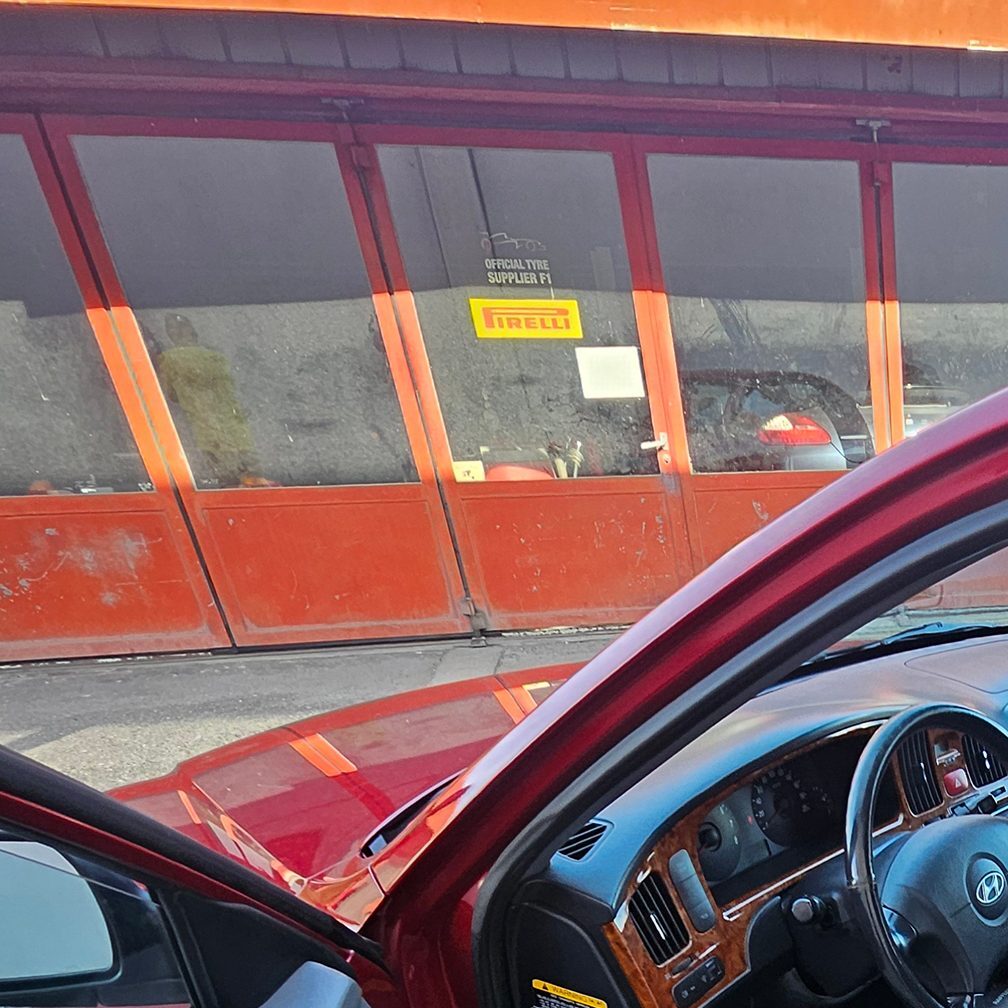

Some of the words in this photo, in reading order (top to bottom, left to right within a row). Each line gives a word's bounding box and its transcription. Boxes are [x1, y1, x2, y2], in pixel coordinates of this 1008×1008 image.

[485, 258, 525, 270] OFFICIAL
[525, 259, 550, 270] TYRE
[487, 271, 538, 284] SUPPLIER
[539, 272, 552, 284] F1
[481, 307, 571, 330] PIRELLI
